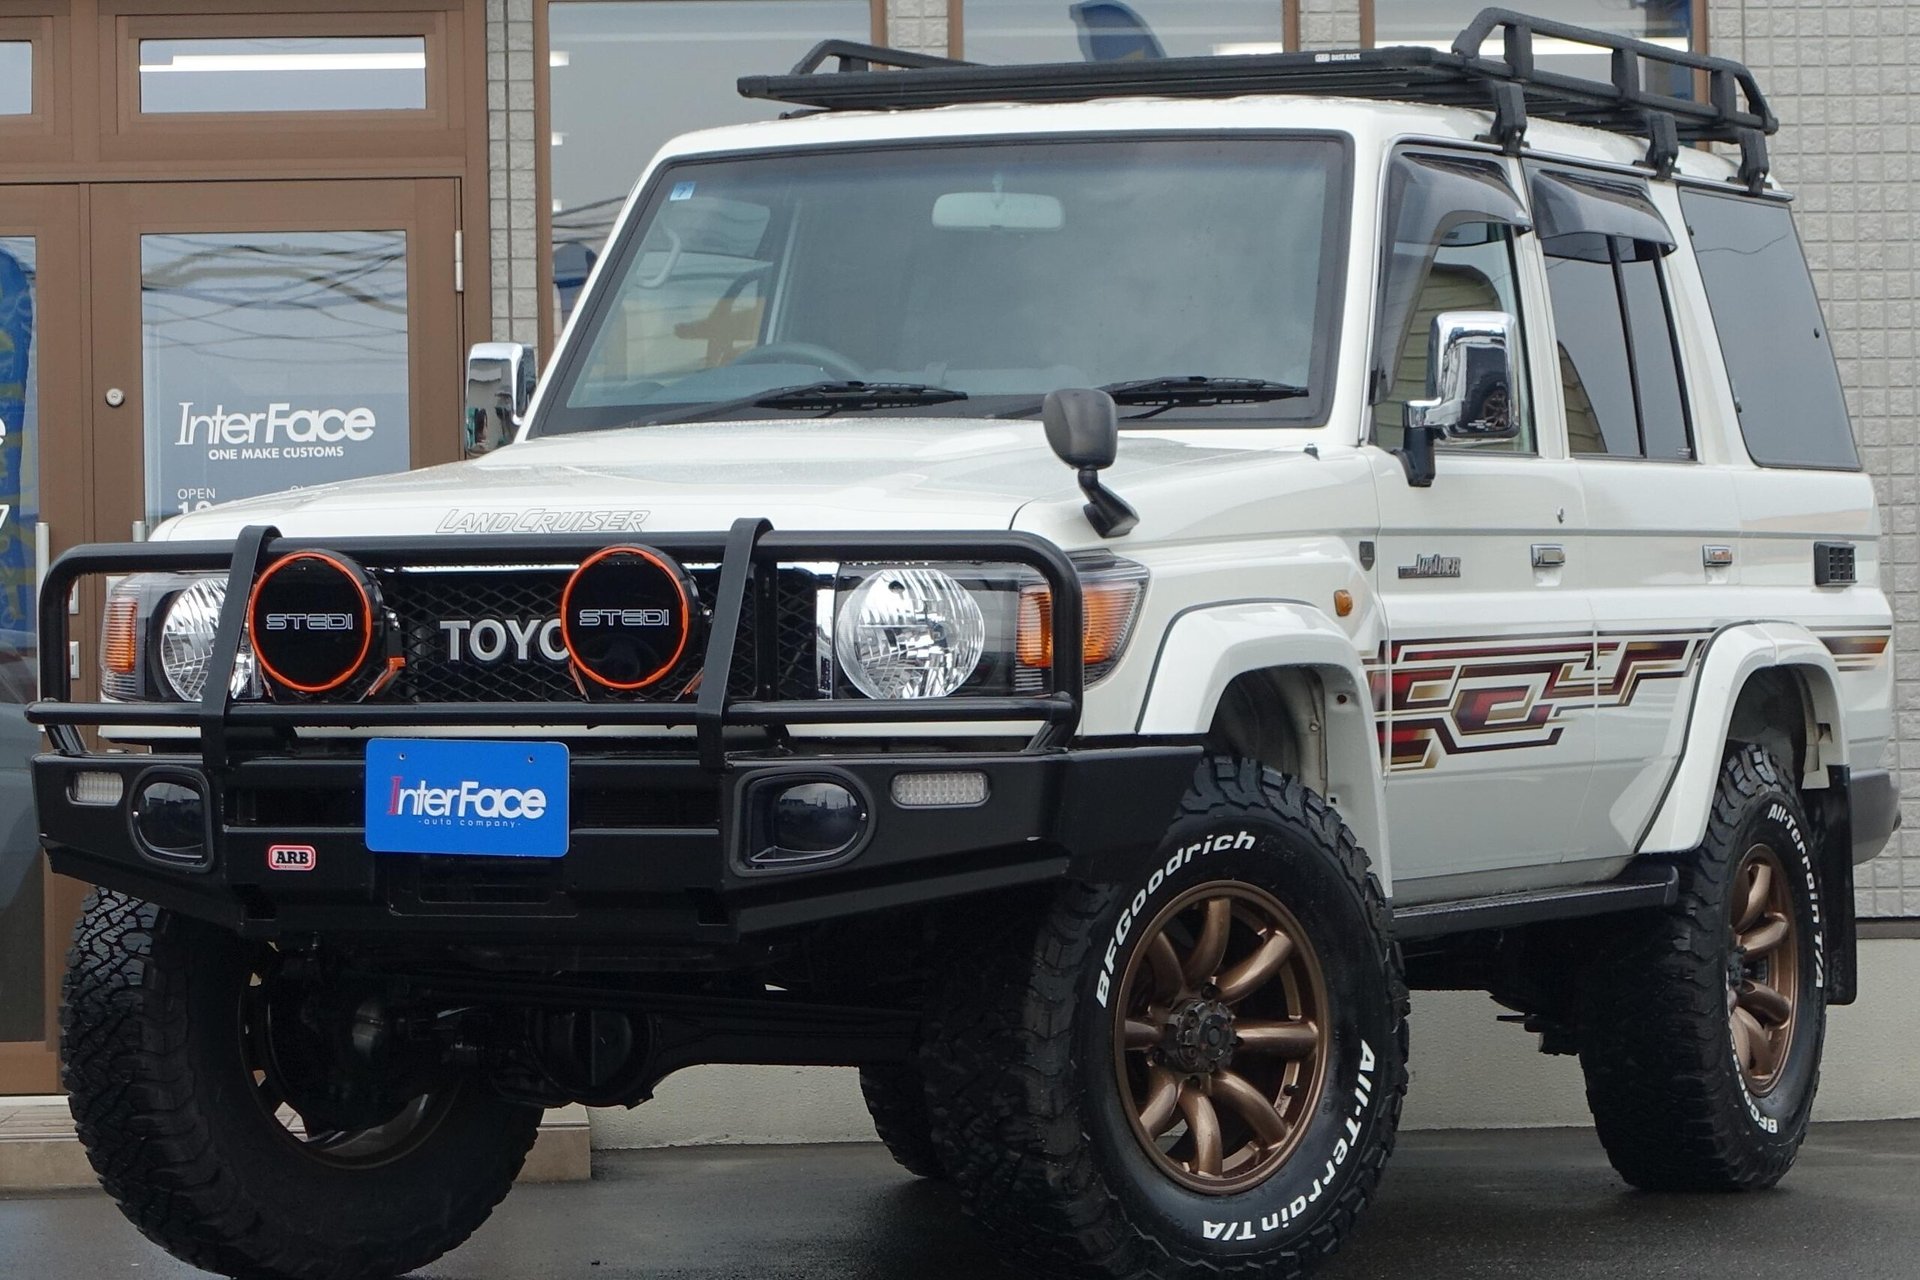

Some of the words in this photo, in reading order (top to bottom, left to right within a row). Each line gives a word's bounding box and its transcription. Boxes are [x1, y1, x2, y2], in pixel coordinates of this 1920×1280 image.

[175, 402, 376, 445] InterFace
[208, 449, 237, 460] ONE
[241, 448, 279, 459] MAKE
[283, 446, 344, 458] CUSTOMS
[177, 488, 216, 500] OPEN
[266, 613, 353, 630] STEDI
[578, 609, 669, 627] STEDI
[387, 776, 546, 819] InterFace
[275, 851, 309, 865] ARB
[1767, 803, 1820, 923] All-Terrain
[1814, 931, 1824, 988] T/A
[1096, 831, 1257, 1009] BFGoodrich
[1261, 1039, 1375, 1232] All-Terrain
[1203, 1220, 1257, 1241] T/A
